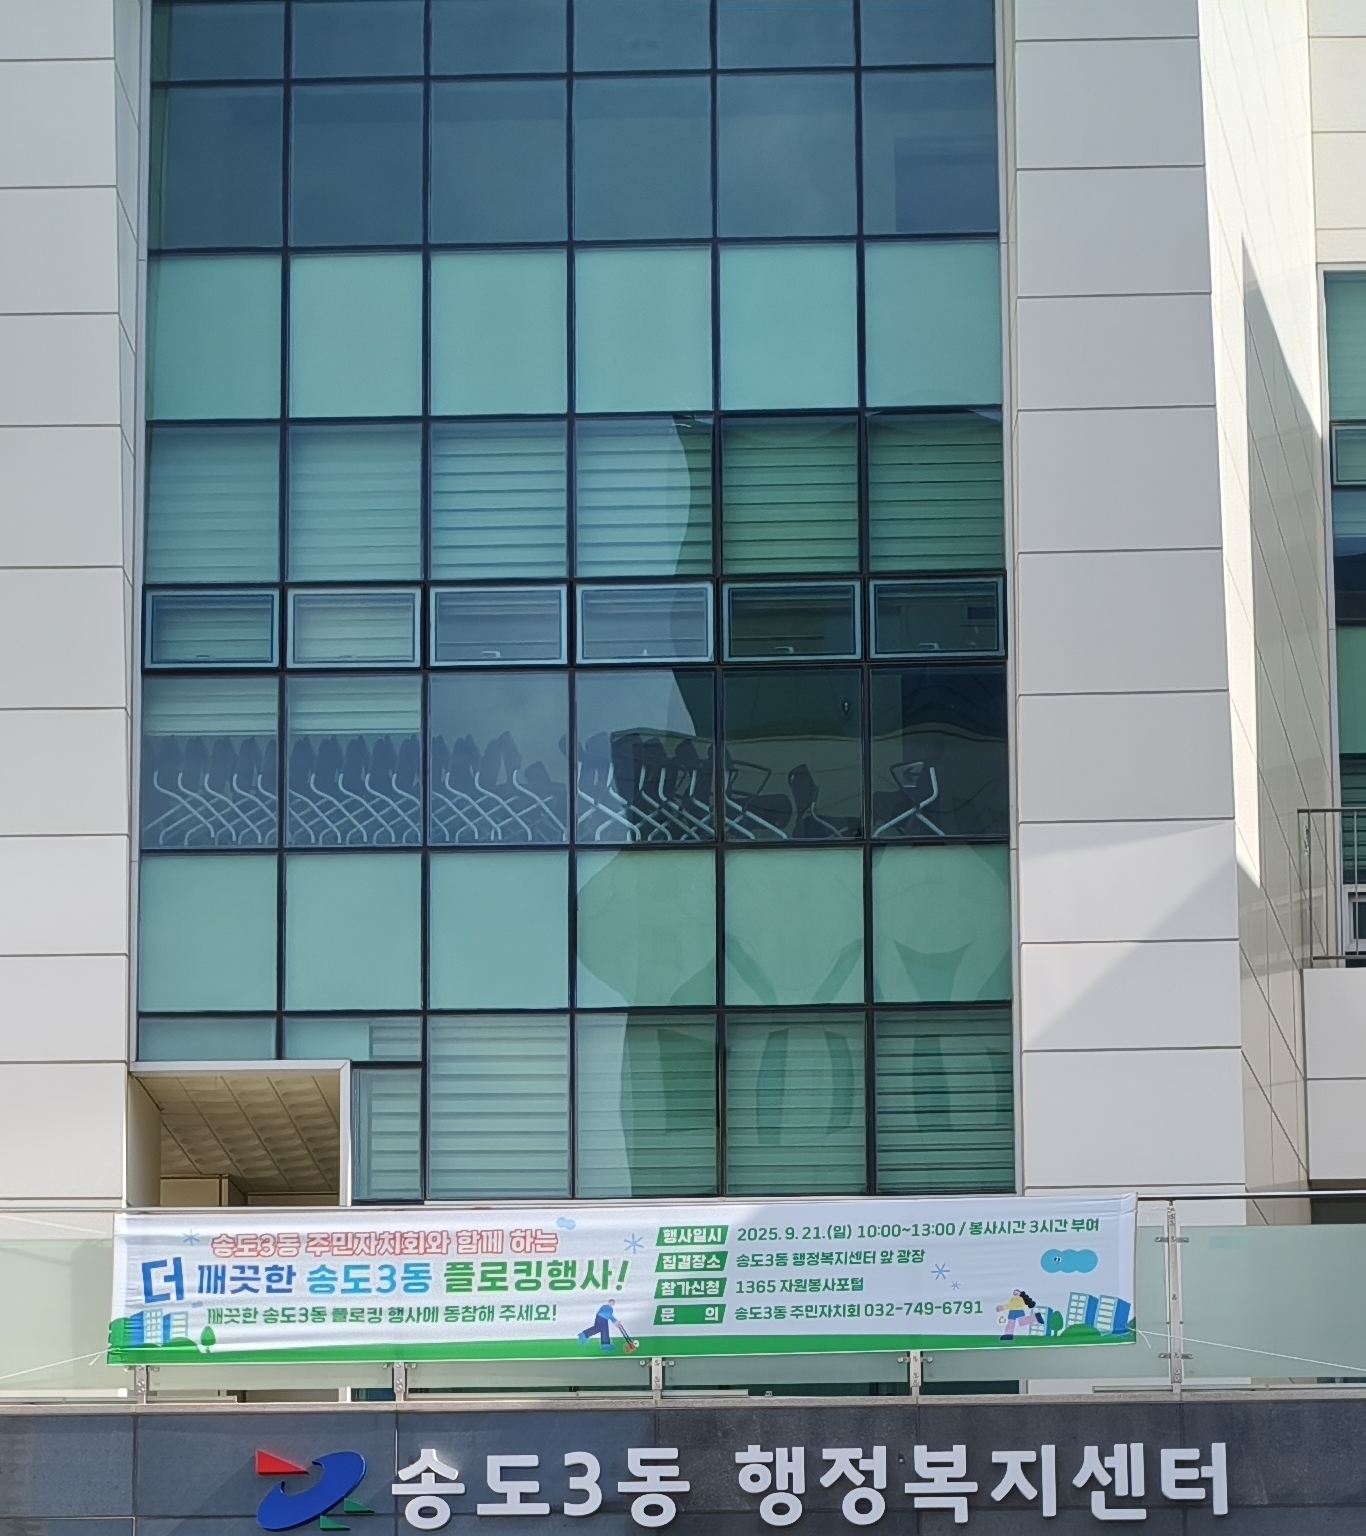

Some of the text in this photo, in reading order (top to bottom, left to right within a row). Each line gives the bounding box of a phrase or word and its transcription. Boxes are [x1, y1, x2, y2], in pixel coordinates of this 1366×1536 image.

[662, 1226, 722, 1244] 행사일시
[857, 1221, 956, 1240] 10:00~13:00
[968, 1219, 1026, 1238] 봉사시간
[1029, 1218, 1068, 1235] 3시간
[1071, 1217, 1100, 1233] 부여
[211, 1228, 559, 1258] 송도3동 주민자치회와 함께 하는
[661, 1252, 722, 1271] 집결장소
[736, 1248, 925, 1269] 송도3동 행정복지센터 앞 광장
[141, 1256, 630, 1304] 더 깨끗한 송도3동 플로킹행사!
[660, 1279, 721, 1296] 참가신청
[736, 1277, 864, 1294] 1365 자원봉사포털
[207, 1303, 557, 1325] 깨끗한 송도3동 플로킹 행사에 동참해 주세요!
[660, 1304, 720, 1323] 문 의
[734, 1300, 983, 1321] 송도3동 주민자치회 032-749-6791
[392, 1440, 1230, 1530] 송도3동 행정복지센터
